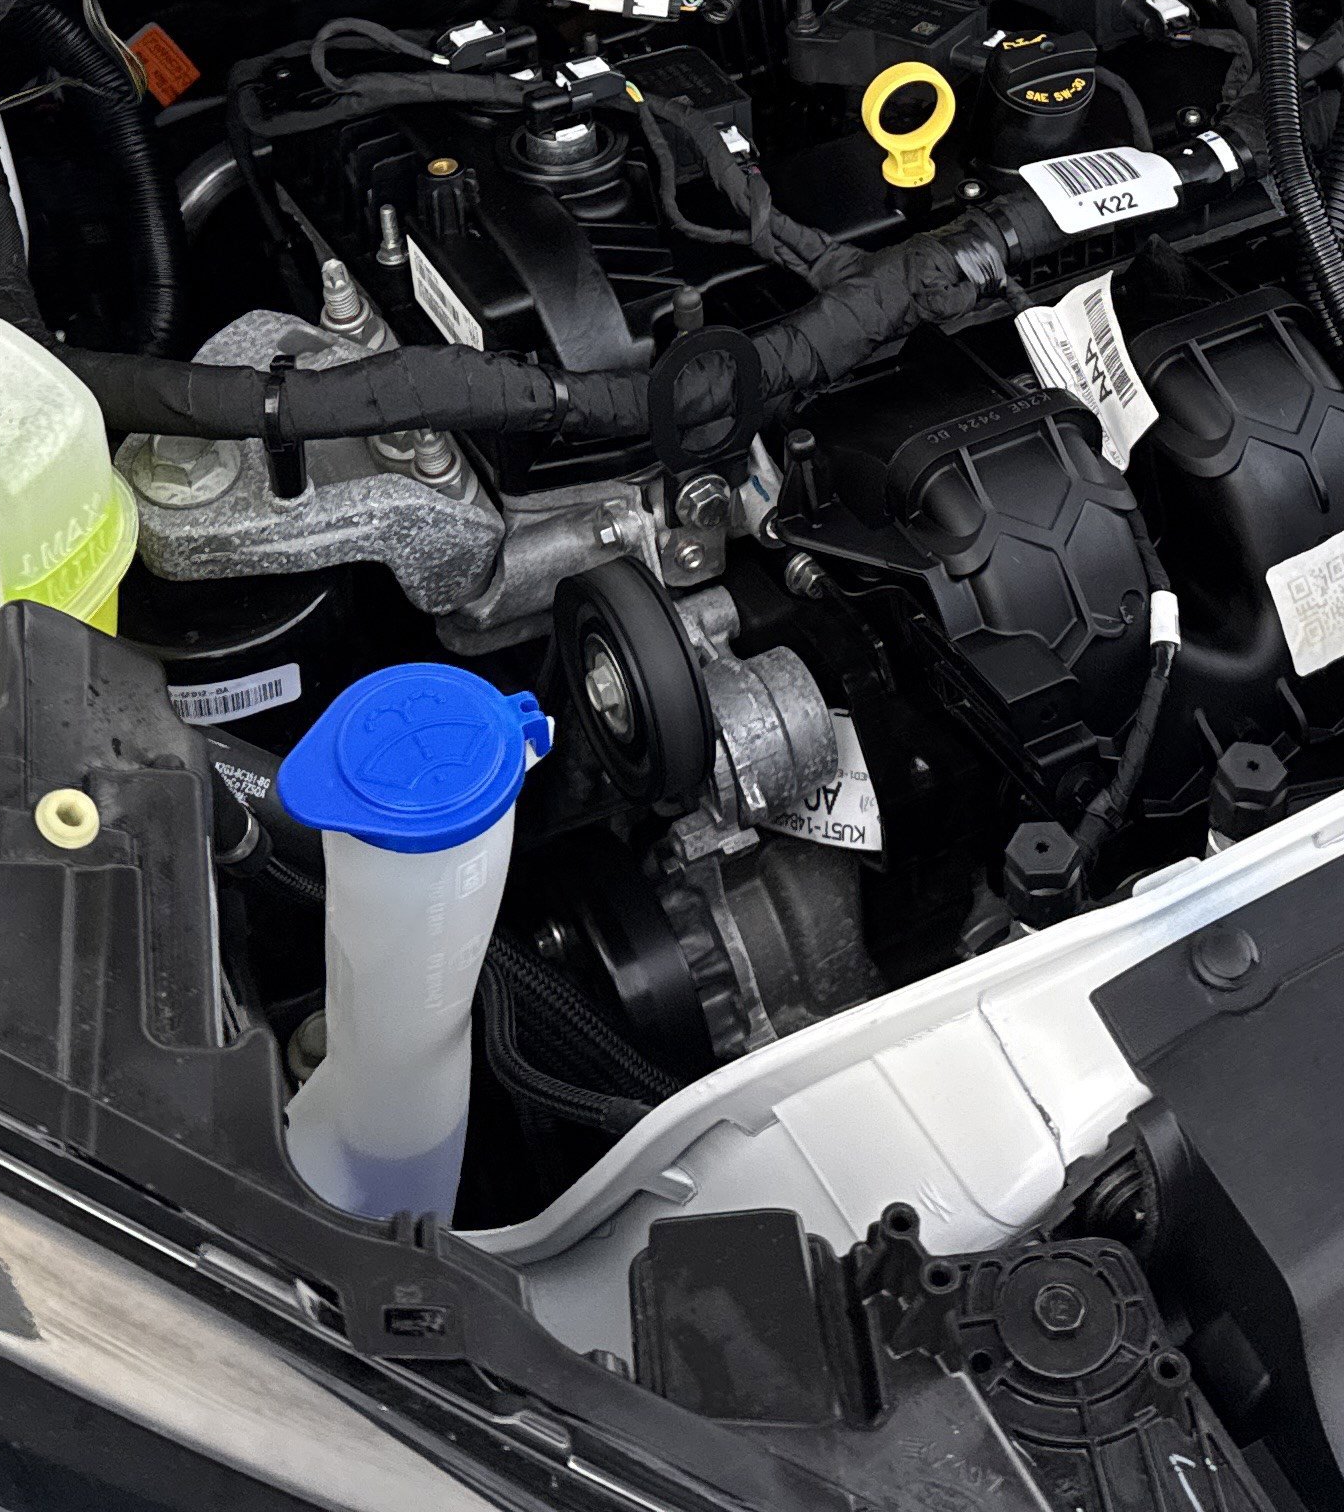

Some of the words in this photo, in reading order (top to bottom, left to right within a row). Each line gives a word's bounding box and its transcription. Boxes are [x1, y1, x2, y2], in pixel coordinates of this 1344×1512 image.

[1024, 88, 1050, 104] SAE
[1052, 76, 1087, 102] 5W-30
[1092, 191, 1140, 217] K22
[40, 492, 107, 567] MAX
